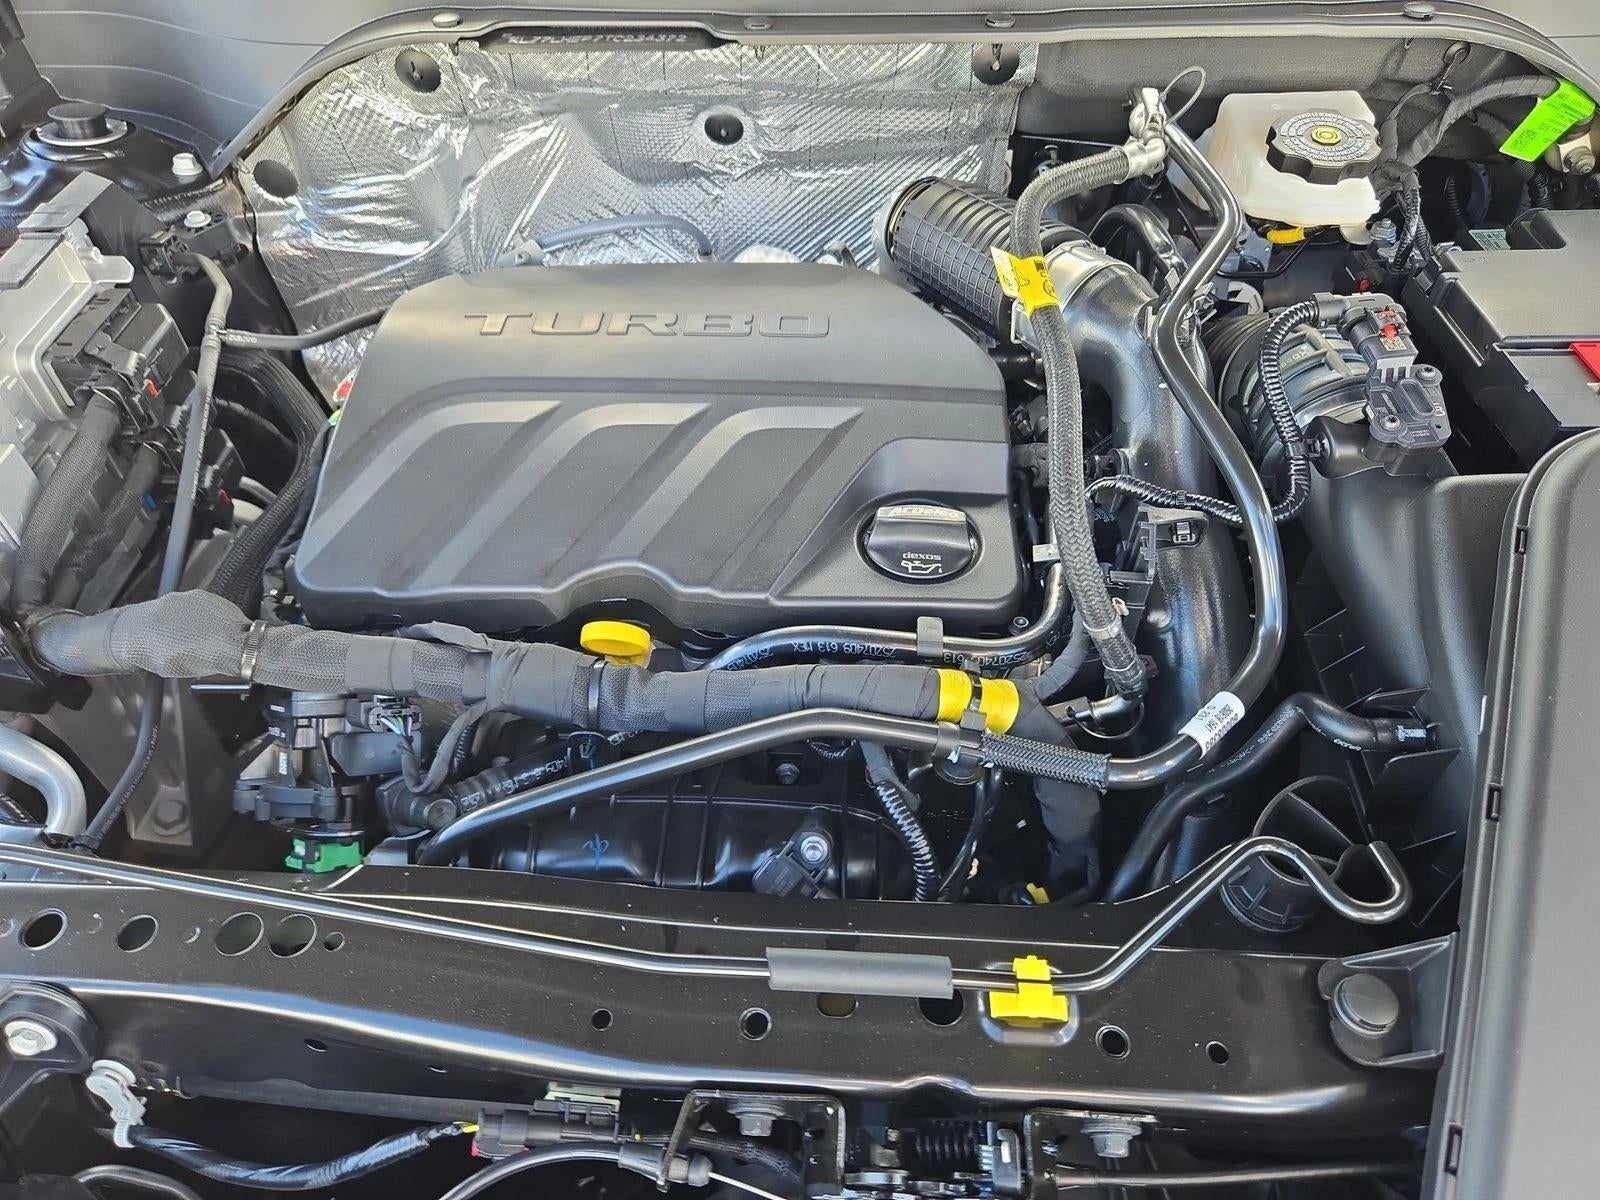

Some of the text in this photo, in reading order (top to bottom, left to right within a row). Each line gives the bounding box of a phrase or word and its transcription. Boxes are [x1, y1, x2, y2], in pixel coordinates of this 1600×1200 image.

[464, 312, 830, 338] TURBO
[902, 551, 942, 561] dexos
[791, 641, 813, 652] MEX
[817, 641, 838, 653] 613
